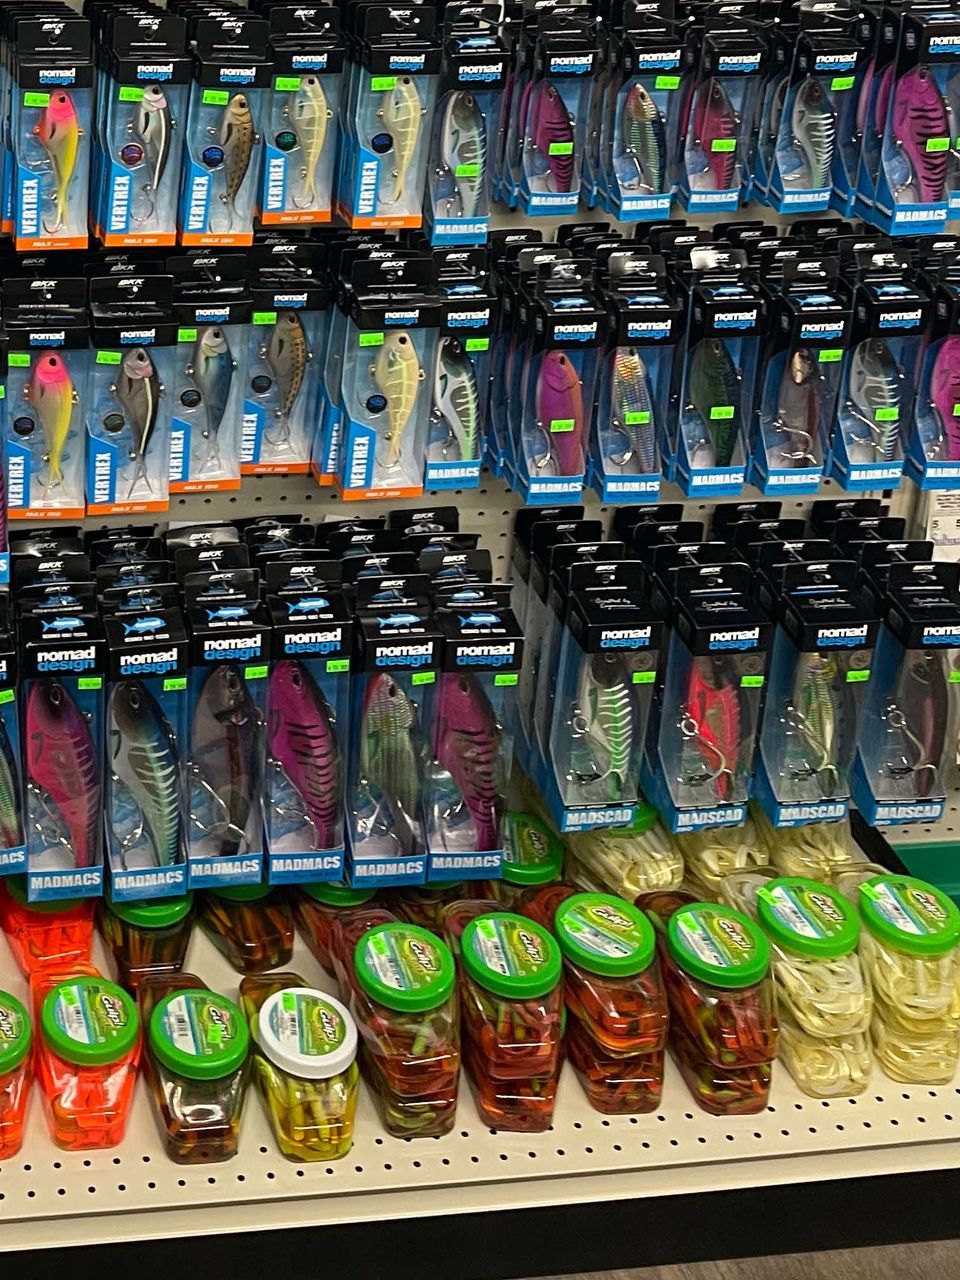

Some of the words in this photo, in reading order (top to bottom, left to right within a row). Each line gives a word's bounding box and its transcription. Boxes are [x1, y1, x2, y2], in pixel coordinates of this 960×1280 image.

[639, 50, 680, 61] nomad
[459, 63, 502, 74] nomad
[639, 60, 679, 69] design
[459, 72, 501, 82] design
[359, 161, 377, 214] VERTREX
[111, 176, 130, 230] VERTREX
[188, 176, 209, 230] VERTREX
[435, 223, 488, 234] MADMACS
[350, 436, 370, 487] VERTREX
[94, 453, 111, 503] VERTREX
[530, 482, 582, 493] MADMACS
[607, 482, 660, 492] MADMACS
[601, 626, 651, 639] nomad
[457, 642, 514, 656] nomad
[600, 637, 649, 648] design
[38, 646, 95, 662] nomad
[456, 654, 513, 666] design
[37, 659, 95, 672] design
[566, 810, 633, 827] MADSCAD
[677, 809, 743, 827] MADSCAD
[780, 806, 845, 822] MADSCAD
[432, 854, 501, 868] MADMACS
[31, 873, 101, 890] MADMACS
[115, 870, 184, 889] MADMACS
